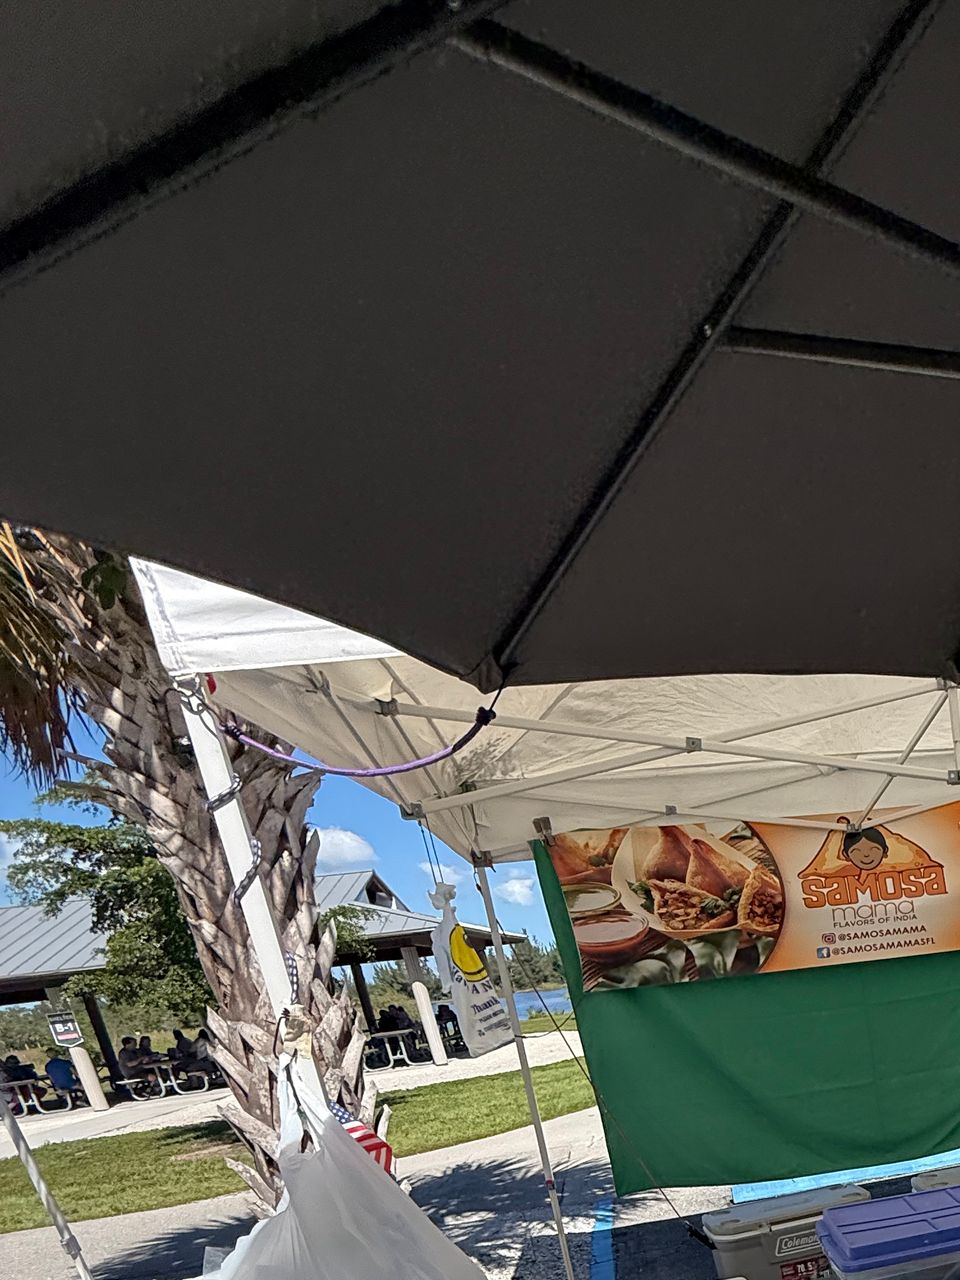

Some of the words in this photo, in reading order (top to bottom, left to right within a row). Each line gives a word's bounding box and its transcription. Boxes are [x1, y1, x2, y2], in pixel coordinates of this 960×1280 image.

[832, 900, 915, 921] mama
[833, 919, 875, 928] FLAVORS
[894, 914, 917, 923] INDIA
[837, 925, 927, 941] @SAMOSAMAMA
[831, 937, 936, 956] @SAMOSAMAMASFL
[55, 1022, 74, 1032] B-1
